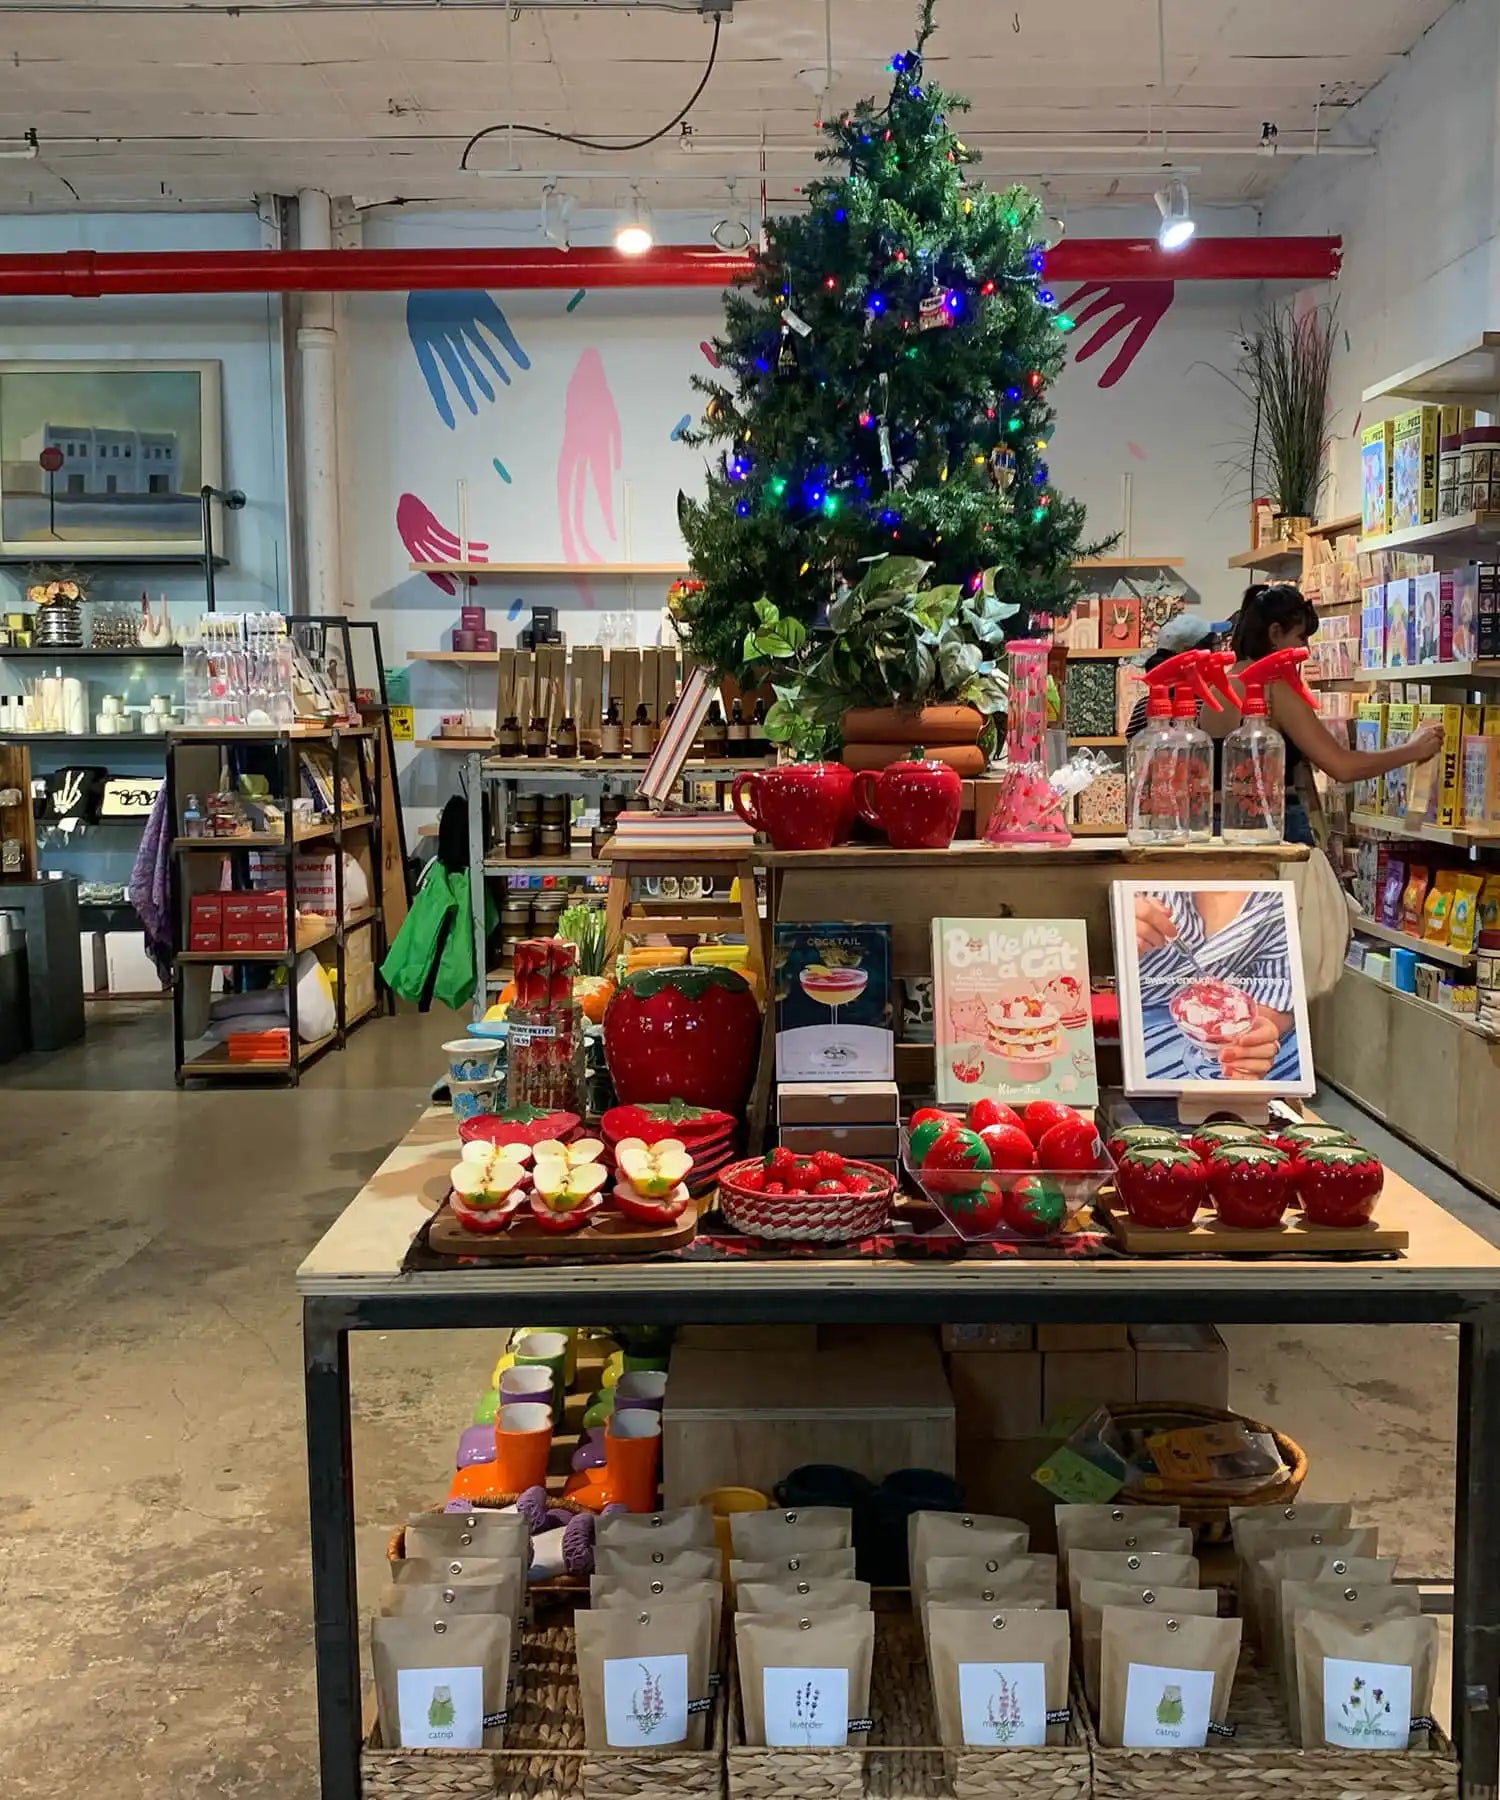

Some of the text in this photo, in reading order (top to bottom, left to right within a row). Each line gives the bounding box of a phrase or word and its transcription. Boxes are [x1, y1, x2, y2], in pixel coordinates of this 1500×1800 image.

[1424, 454, 1434, 525] LE PUZZ
[1443, 753, 1456, 825] LE PUZZ
[807, 937, 861, 946] COCKTAIL
[943, 925, 1063, 968] Bake Me
[998, 941, 1079, 978] a Cat
[428, 1731, 454, 1740] catnip
[790, 1719, 824, 1729] lavender
[1155, 1728, 1181, 1738] catnip
